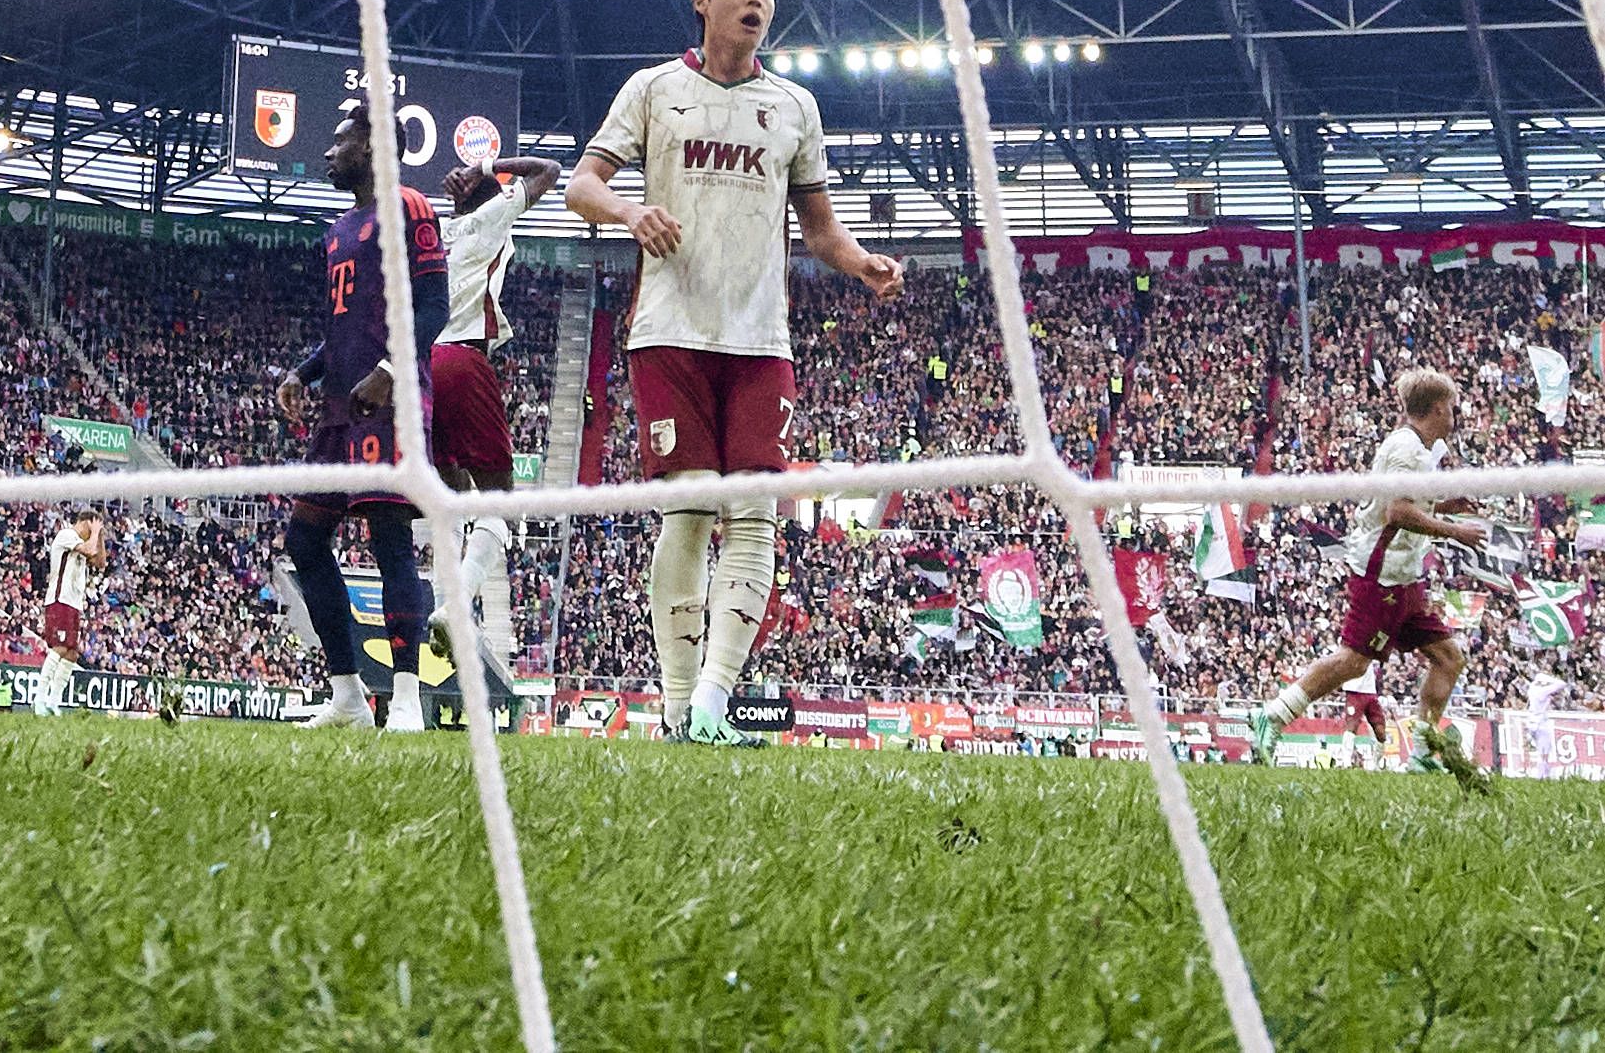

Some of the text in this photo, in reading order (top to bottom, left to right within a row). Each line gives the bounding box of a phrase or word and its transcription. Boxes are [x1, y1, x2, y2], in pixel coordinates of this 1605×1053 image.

[241, 43, 269, 57] 16:04
[684, 139, 767, 177] WWK
[779, 396, 794, 440] 7
[81, 427, 127, 449] ARENA
[736, 706, 789, 721] CONNY
[795, 710, 867, 729] DISSIDENTS
